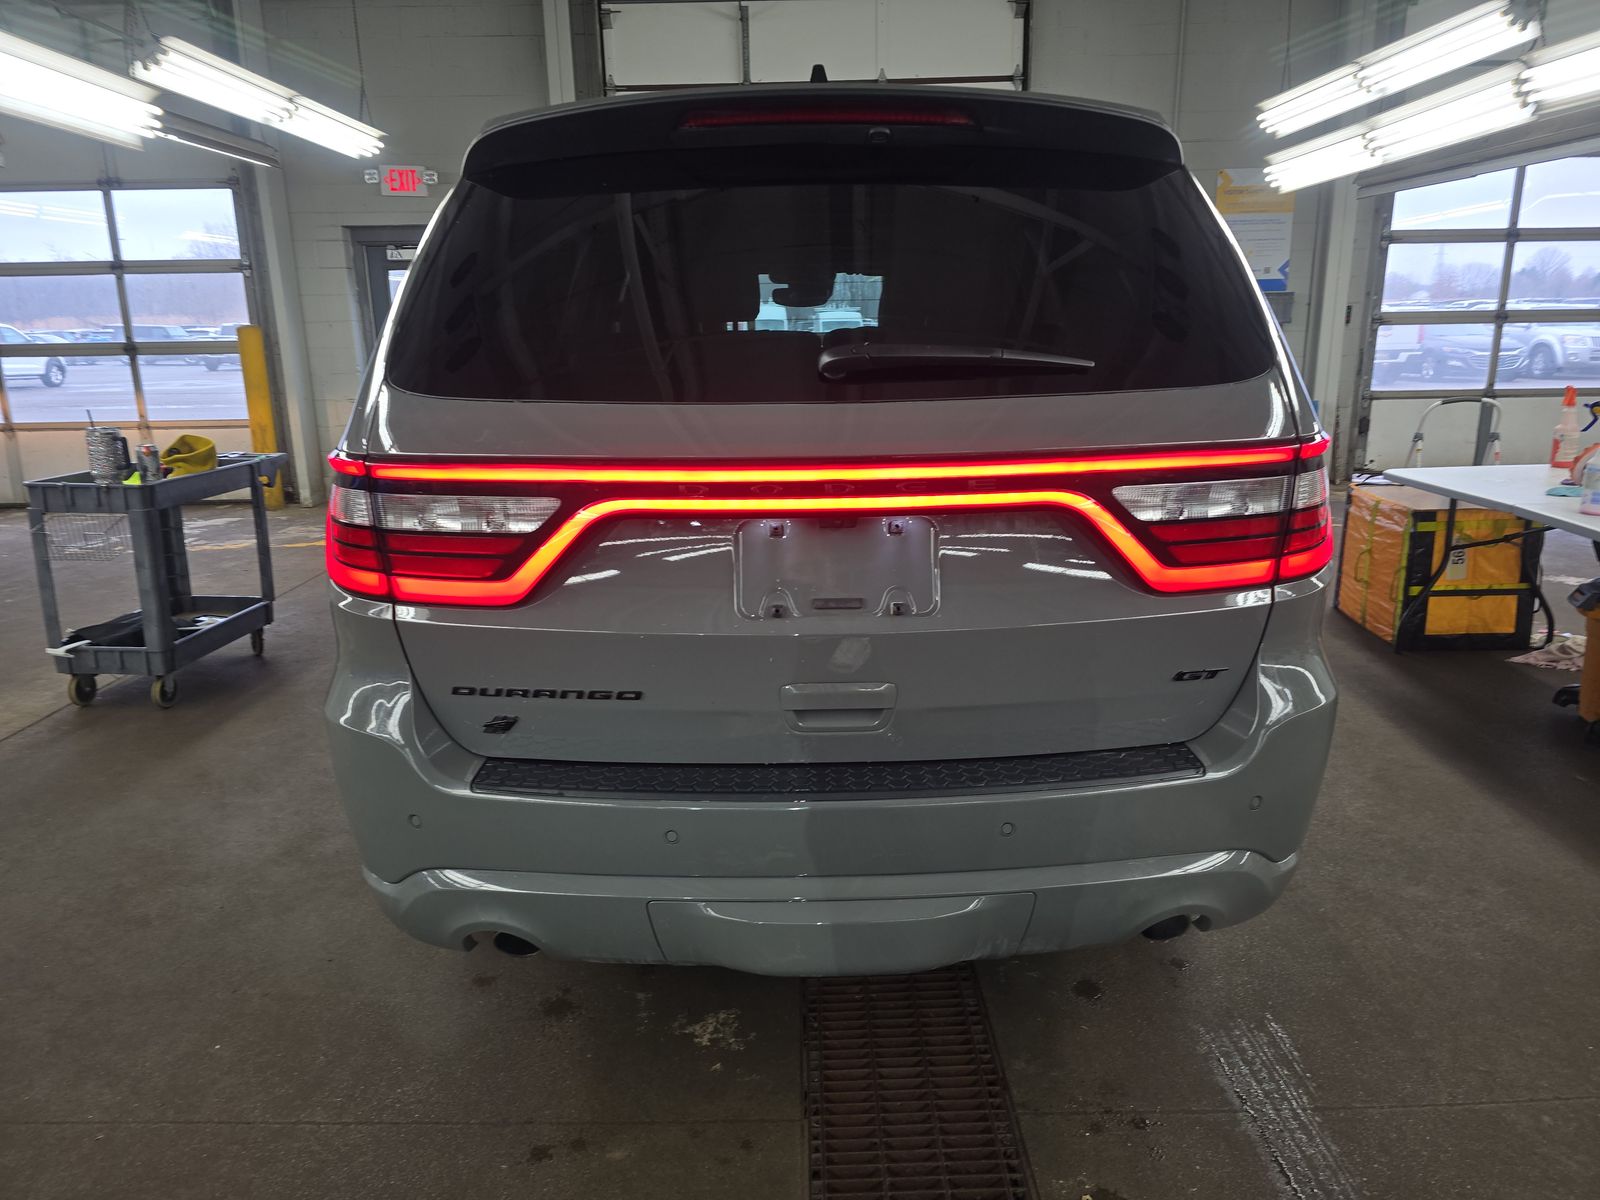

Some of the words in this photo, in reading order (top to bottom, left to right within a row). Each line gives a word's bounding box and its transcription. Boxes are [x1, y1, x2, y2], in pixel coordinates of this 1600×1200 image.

[389, 169, 417, 192] EXIT
[1172, 667, 1229, 681] GT
[452, 686, 644, 701] DURANGO
